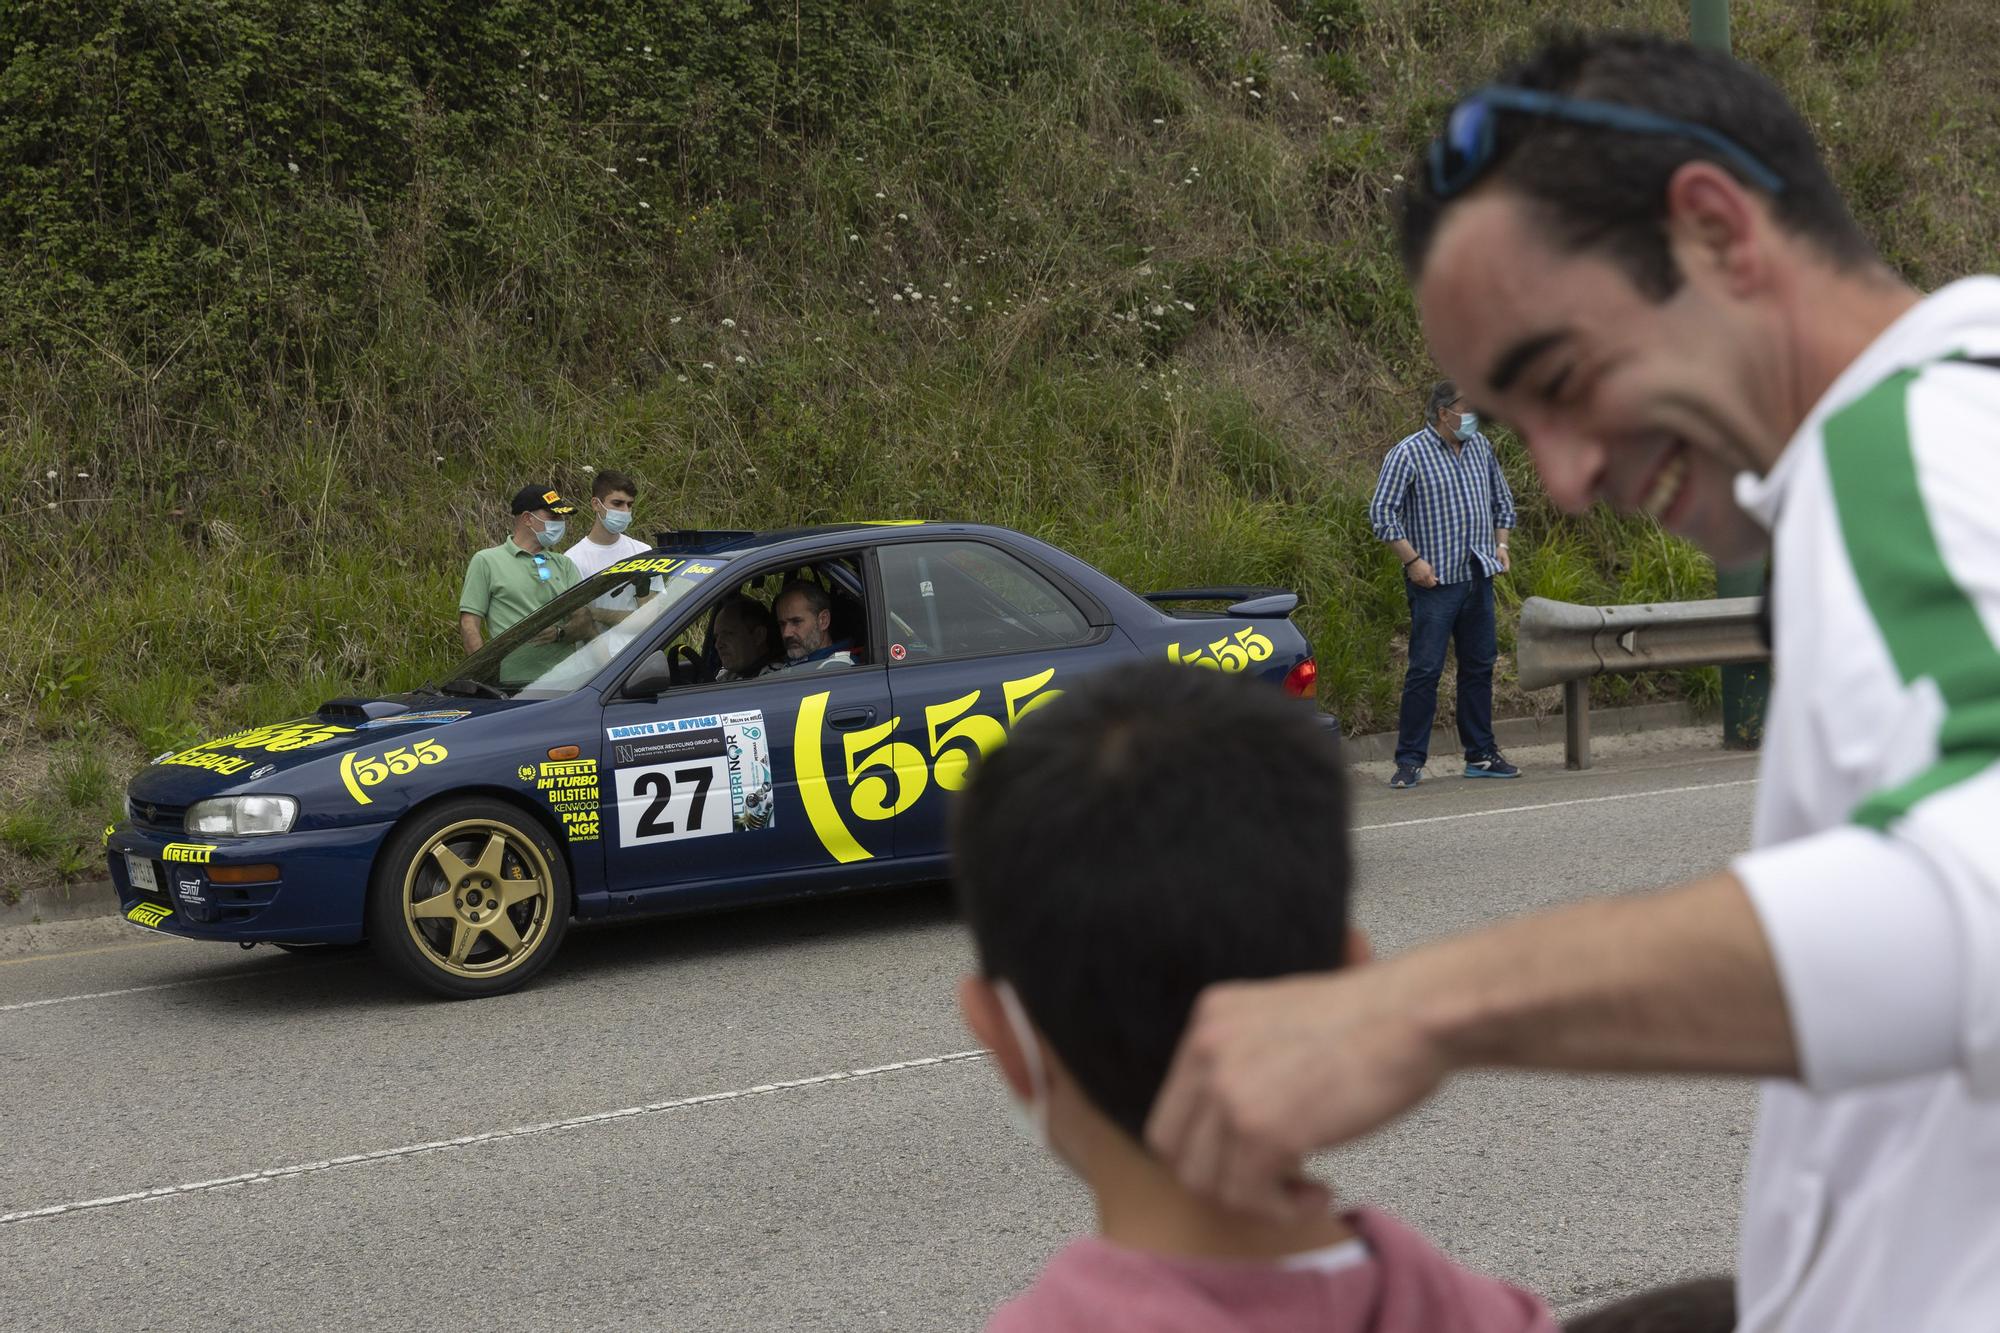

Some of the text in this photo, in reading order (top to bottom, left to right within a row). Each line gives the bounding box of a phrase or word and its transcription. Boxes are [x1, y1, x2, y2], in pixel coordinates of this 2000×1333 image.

[657, 721, 676, 733] DE
[664, 741, 694, 751] RECYCLING
[540, 759, 597, 777] PIRELLI
[537, 775, 598, 789] IHI TURBO
[549, 787, 599, 803] BILSTEIN
[633, 765, 713, 838] 27
[554, 801, 599, 812] KENWOOD
[562, 811, 599, 823] PIAA
[569, 822, 599, 836] NGK
[163, 843, 217, 863] PIRELLI
[128, 902, 174, 928] PIRELLI
